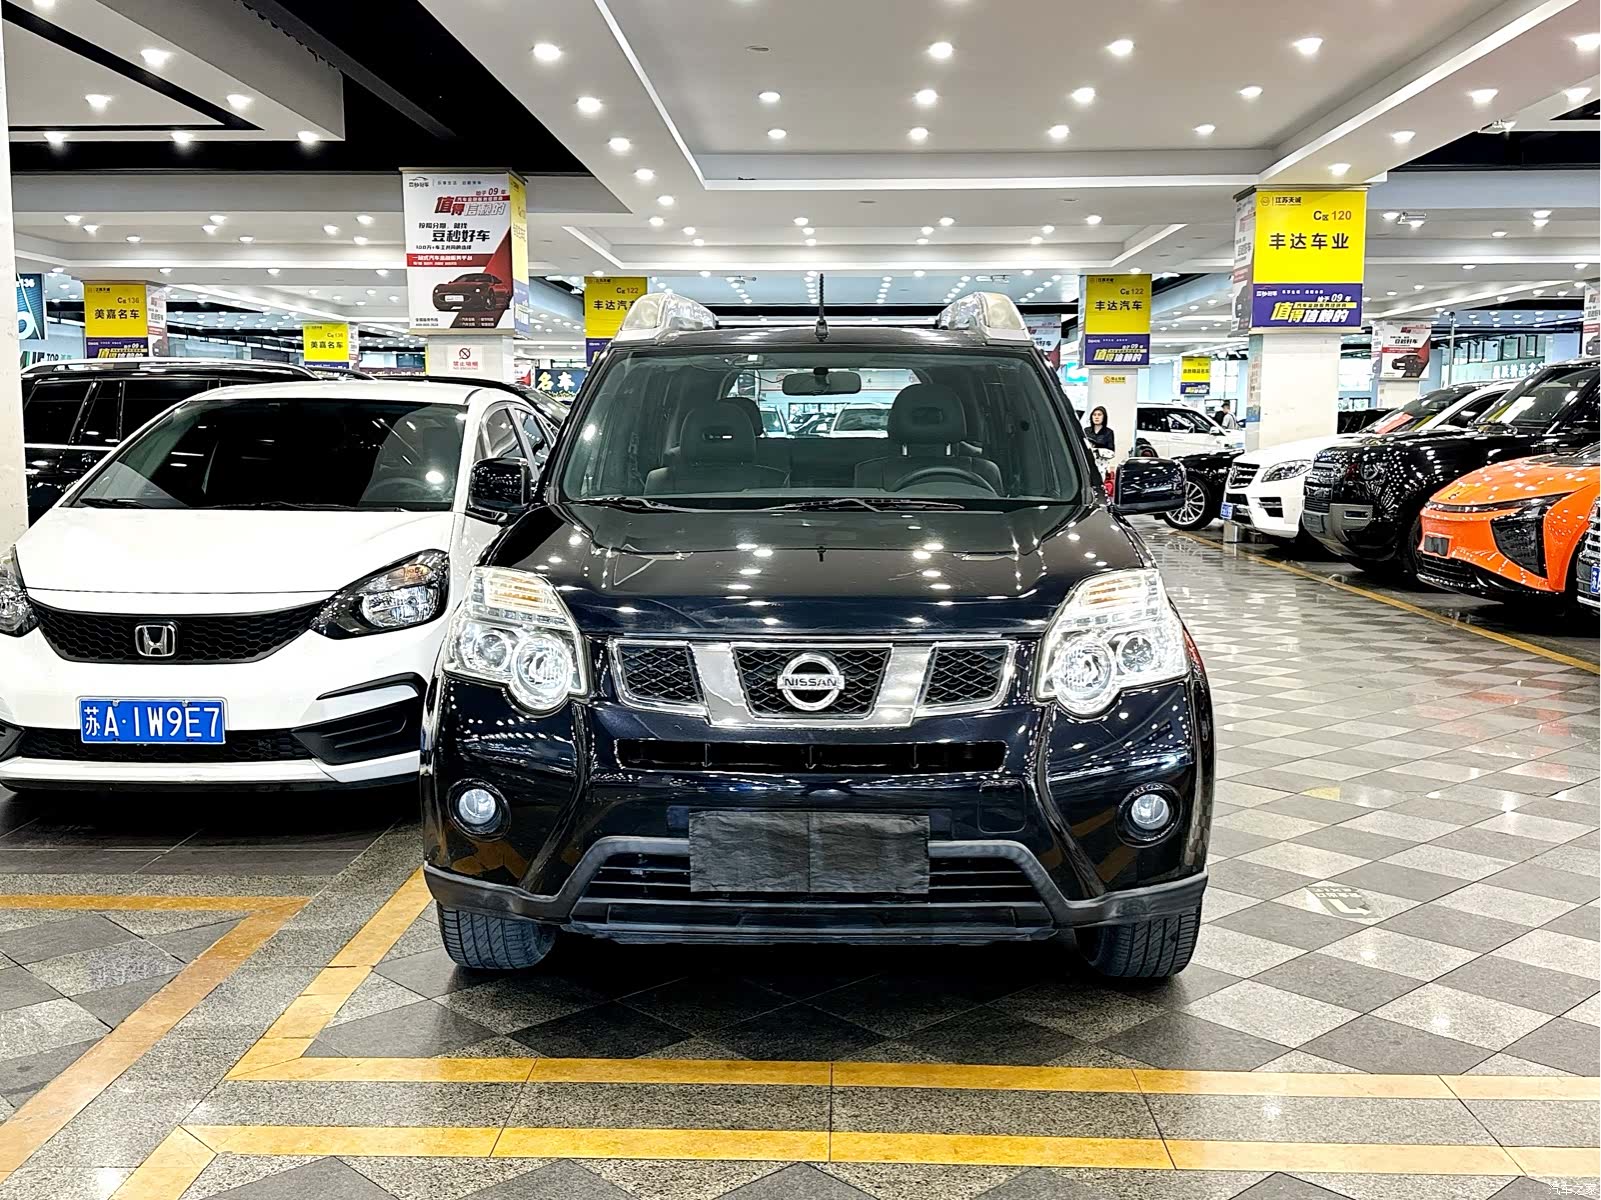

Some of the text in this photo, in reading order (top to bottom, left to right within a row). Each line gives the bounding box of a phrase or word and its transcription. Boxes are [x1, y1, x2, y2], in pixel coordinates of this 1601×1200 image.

[434, 196, 505, 216] 值得信赖的
[1331, 211, 1352, 220] 120
[432, 230, 490, 242] 豆秒好车
[1269, 232, 1349, 250] 丰达车业
[1095, 300, 1142, 311] 丰达汽车
[94, 308, 140, 319] 美嘉名车
[1270, 302, 1349, 323] 值得信赖的
[784, 678, 837, 686] NISSAN
